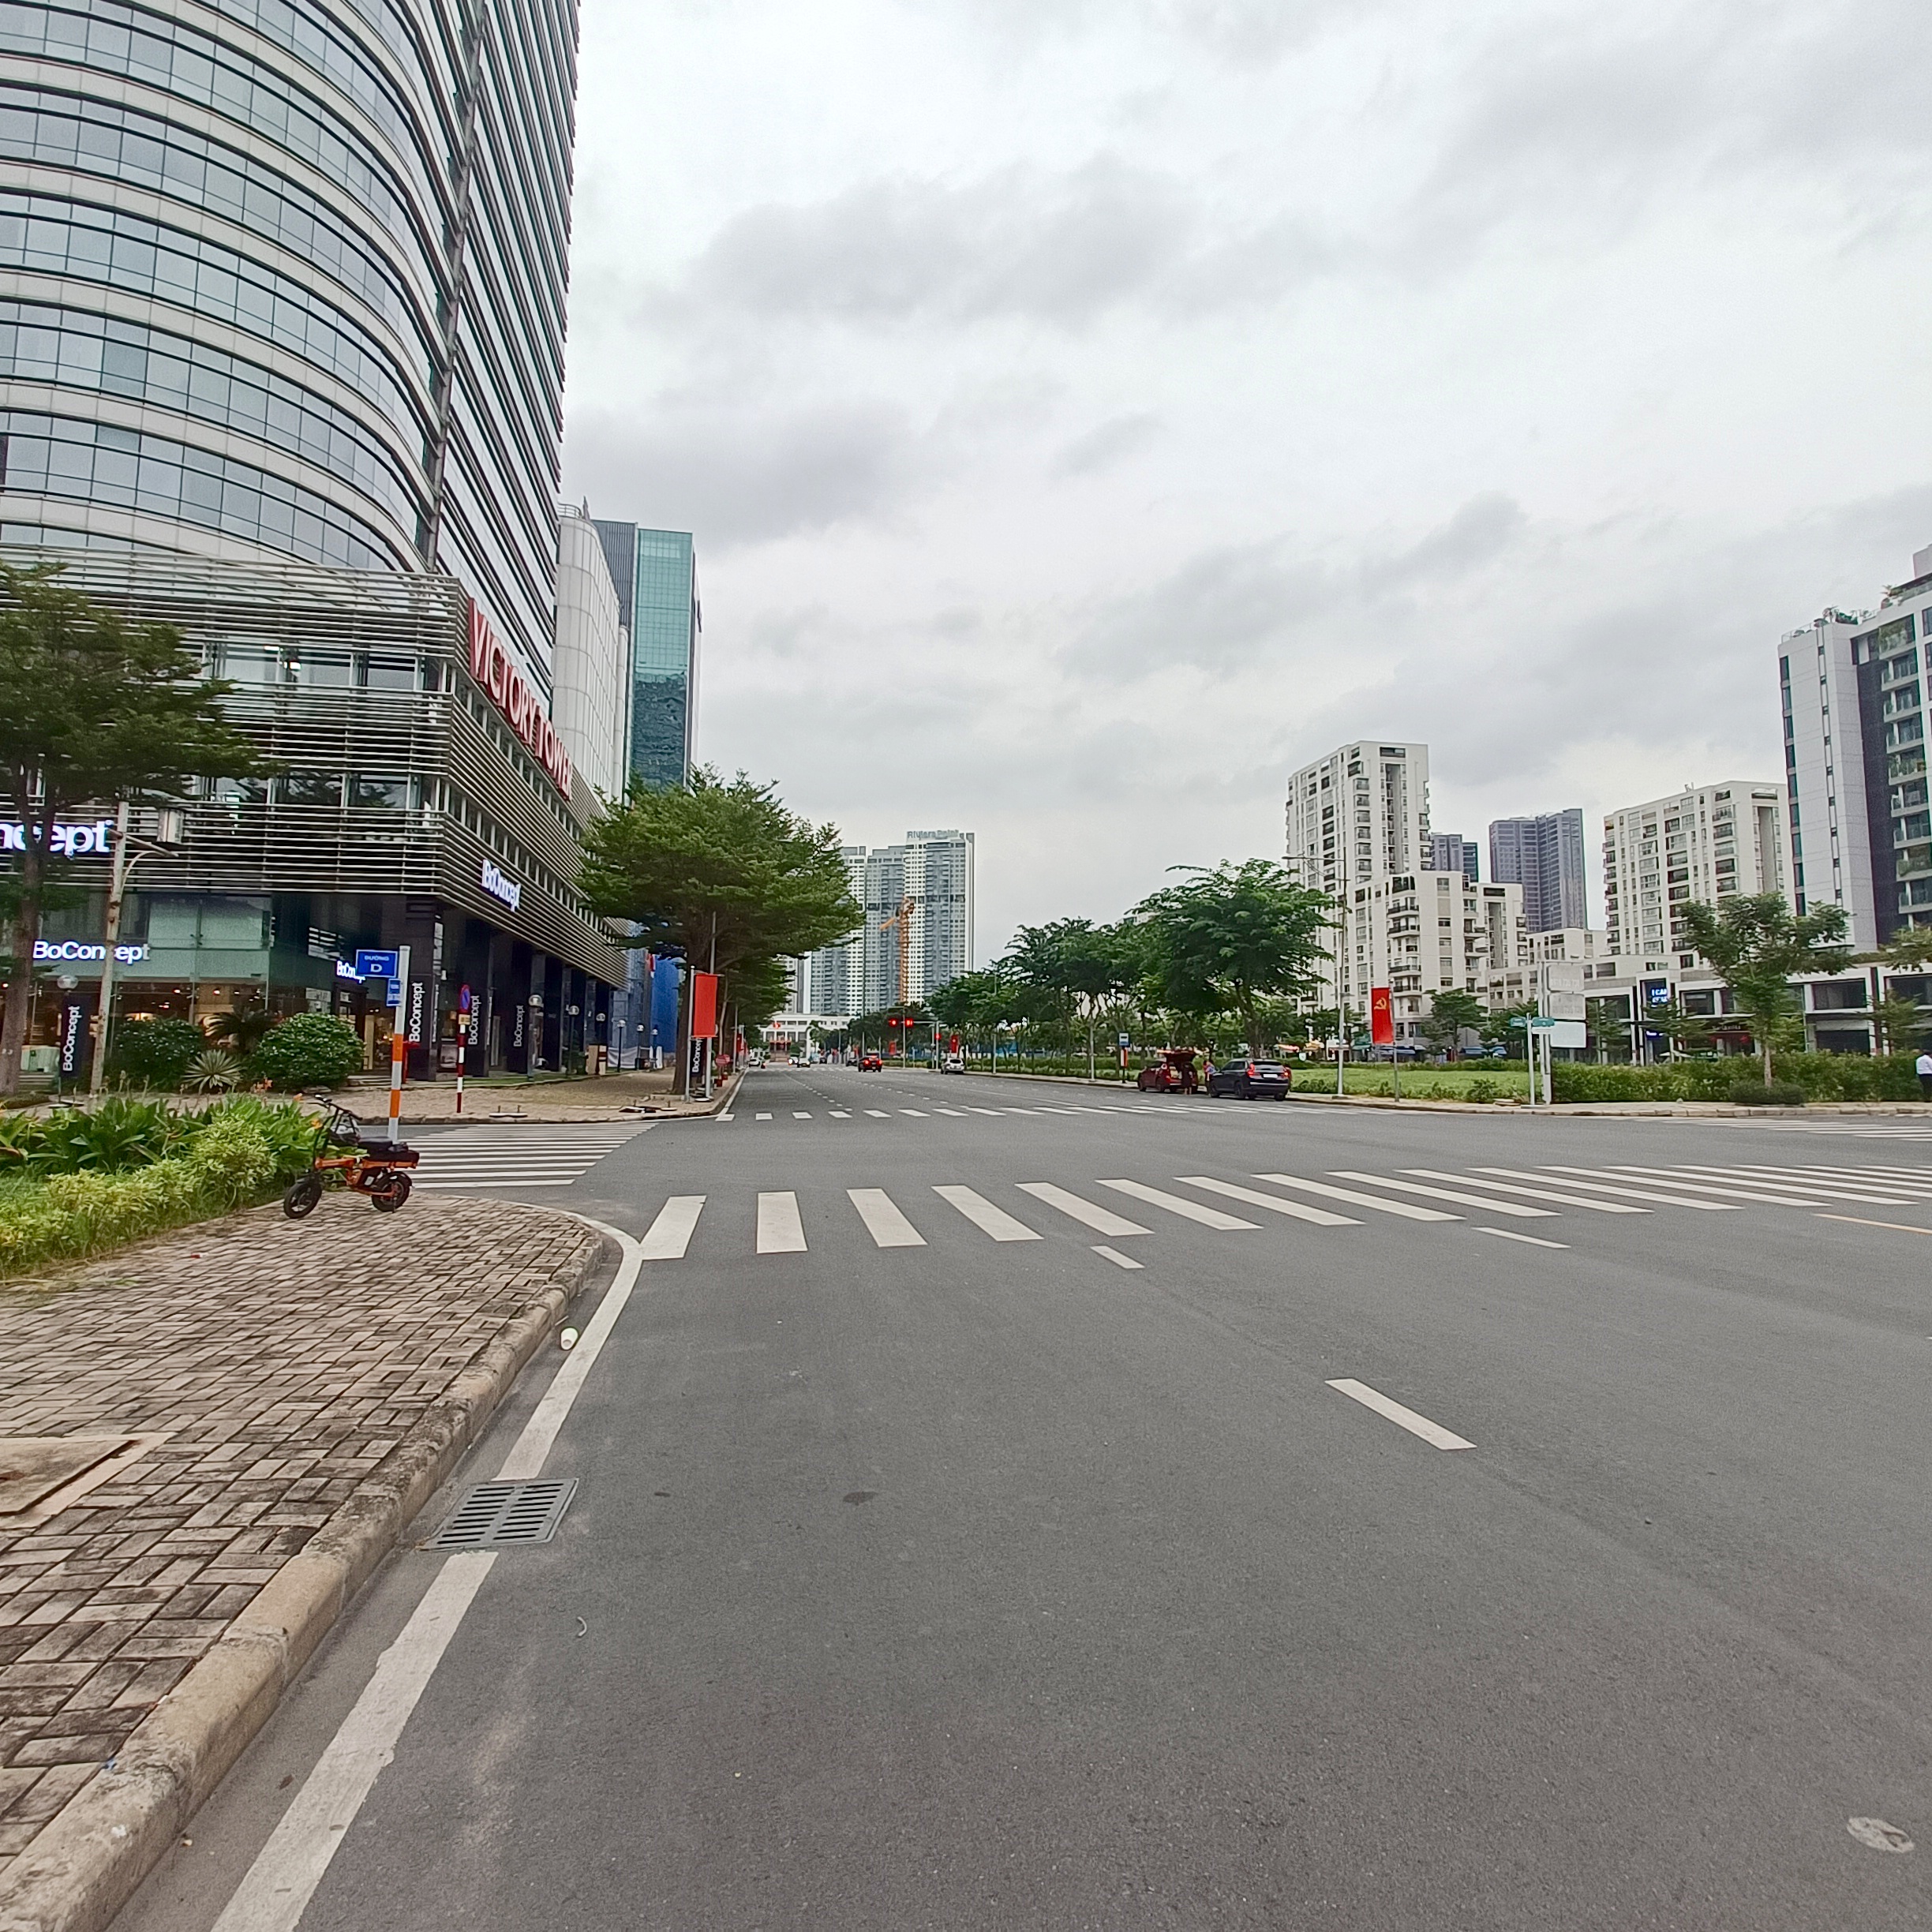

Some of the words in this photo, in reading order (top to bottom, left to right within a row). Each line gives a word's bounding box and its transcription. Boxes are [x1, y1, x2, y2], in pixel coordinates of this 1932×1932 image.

[469, 598, 537, 745] VICTORY
[534, 705, 573, 802] TOWER
[482, 859, 521, 912] BoConcept
[32, 941, 150, 964] BoConept
[371, 964, 382, 972] D
[409, 982, 425, 1042] BoConcept
[468, 996, 481, 1045] BoConcept
[514, 1005, 525, 1046] BoConcept
[63, 1005, 82, 1071] BoConcept
